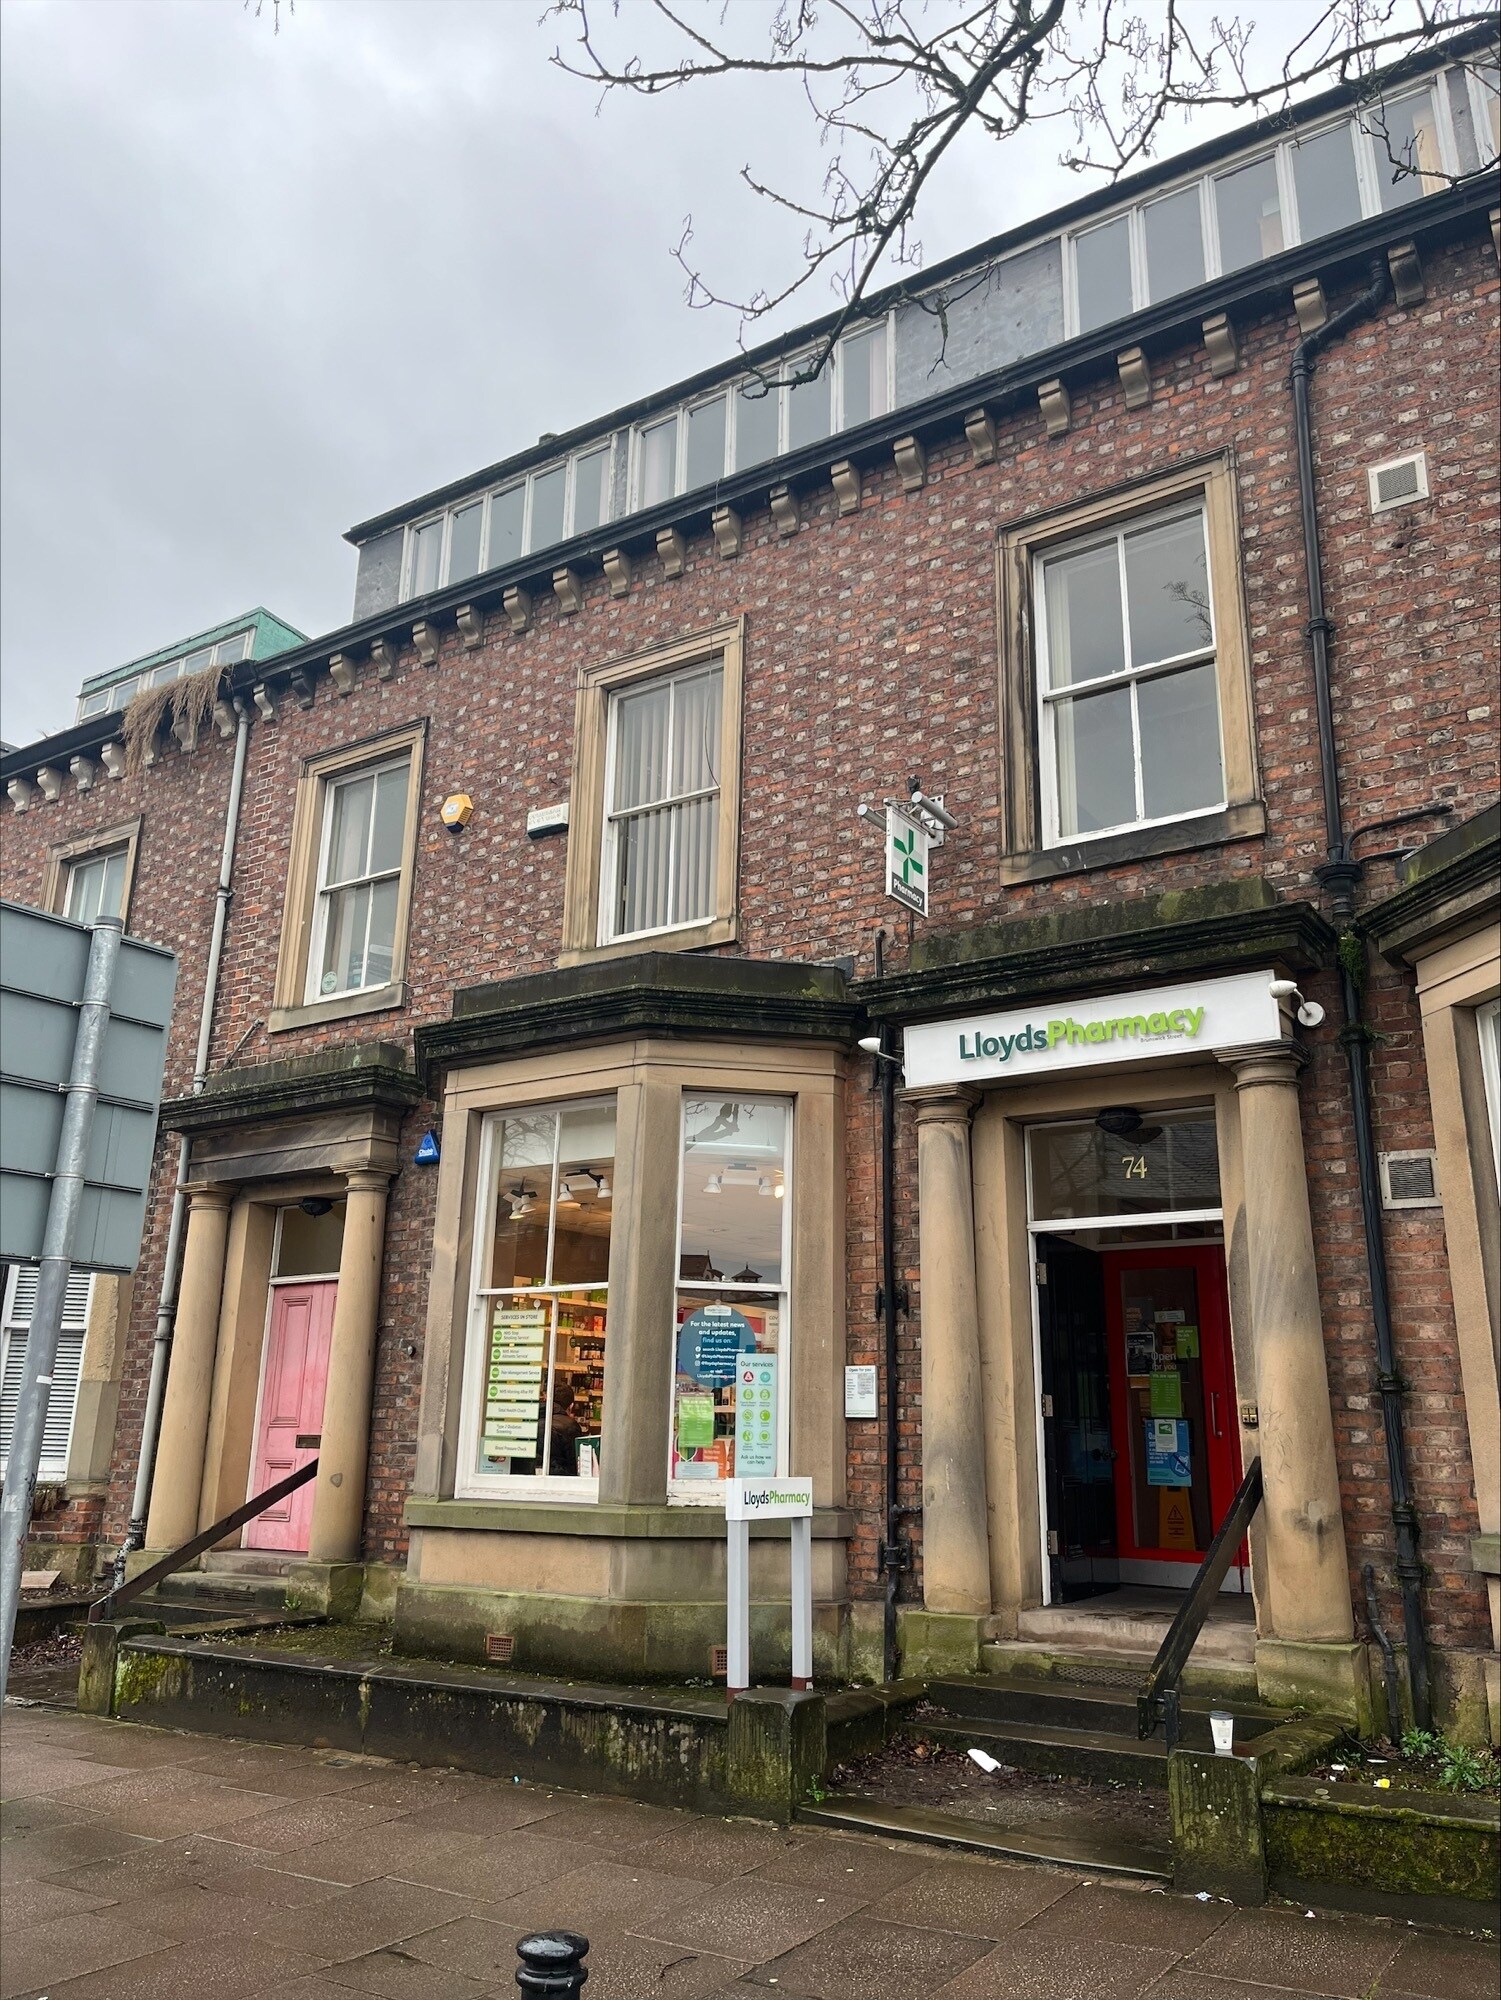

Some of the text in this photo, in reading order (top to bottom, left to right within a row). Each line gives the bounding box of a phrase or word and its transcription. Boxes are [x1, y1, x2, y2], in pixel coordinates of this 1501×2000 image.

[893, 878, 923, 907] Pharmacy
[958, 1005, 1205, 1062] LloydsPharmacy
[1121, 1155, 1148, 1179] 74
[1151, 1351, 1177, 1363] Open
[1164, 1364, 1177, 1373] you
[743, 1489, 811, 1509] LloydsPharmacy
